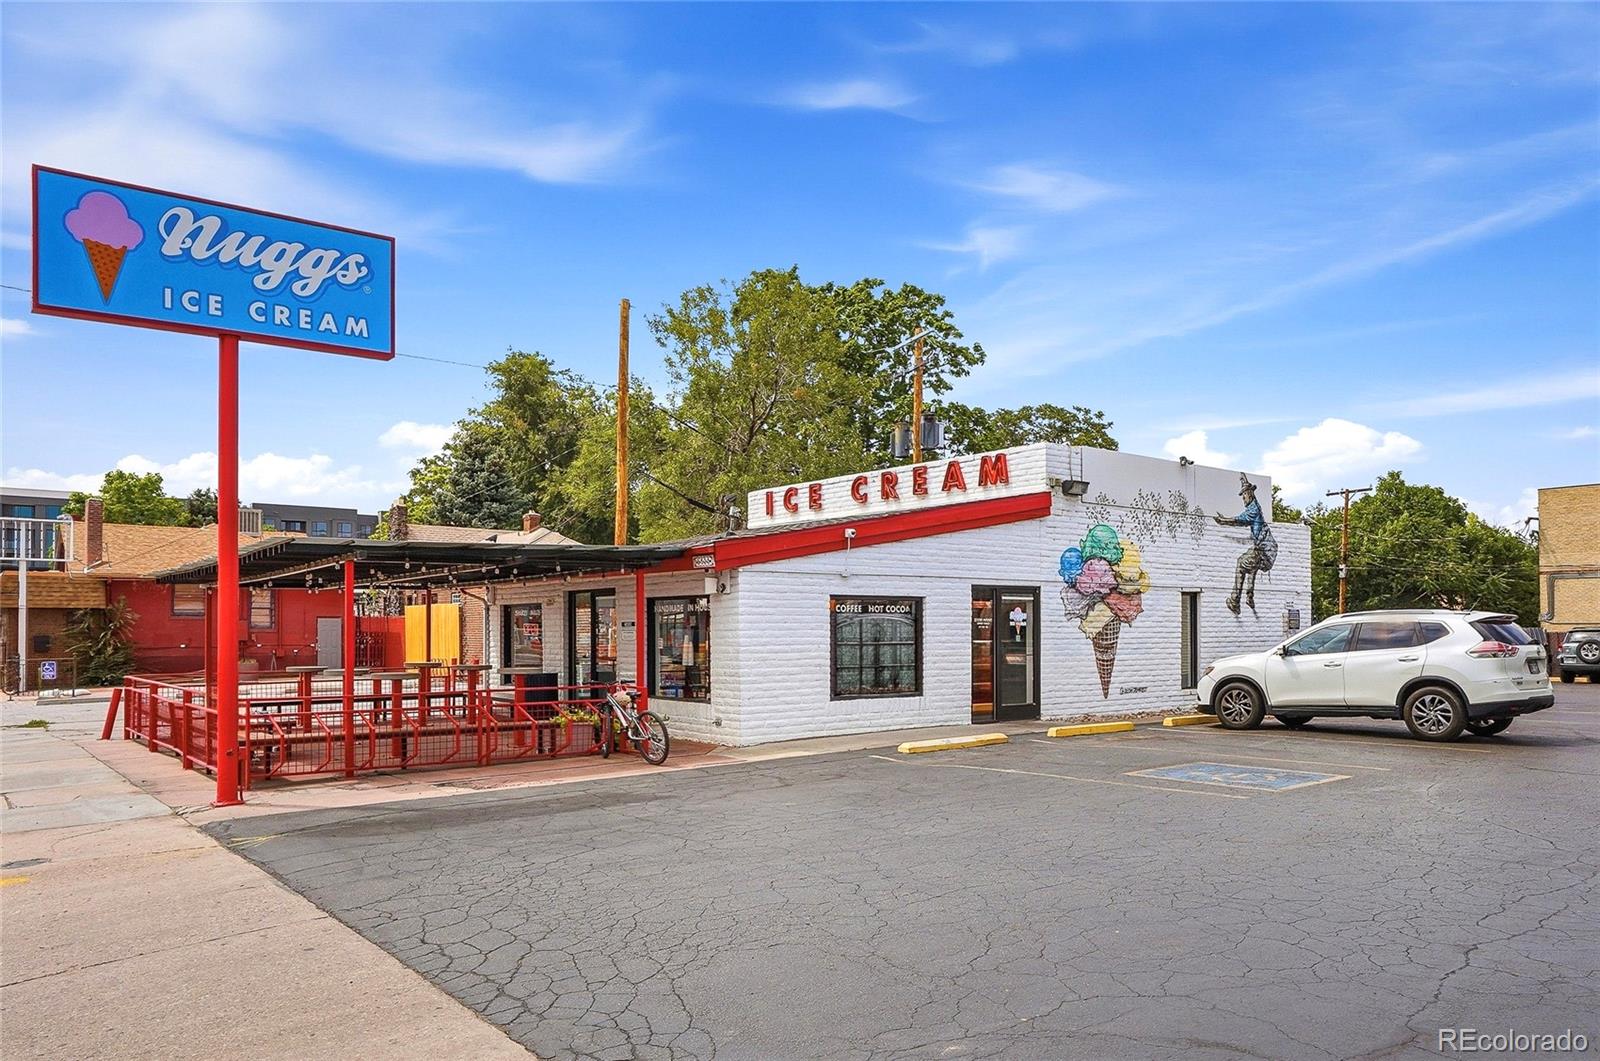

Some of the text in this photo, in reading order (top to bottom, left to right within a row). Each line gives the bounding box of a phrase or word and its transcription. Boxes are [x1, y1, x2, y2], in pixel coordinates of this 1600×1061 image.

[163, 287, 369, 338] ICE CREAM
[765, 453, 1010, 516] ICE CREAM
[835, 604, 911, 613] COFFEE HOT COCOA
